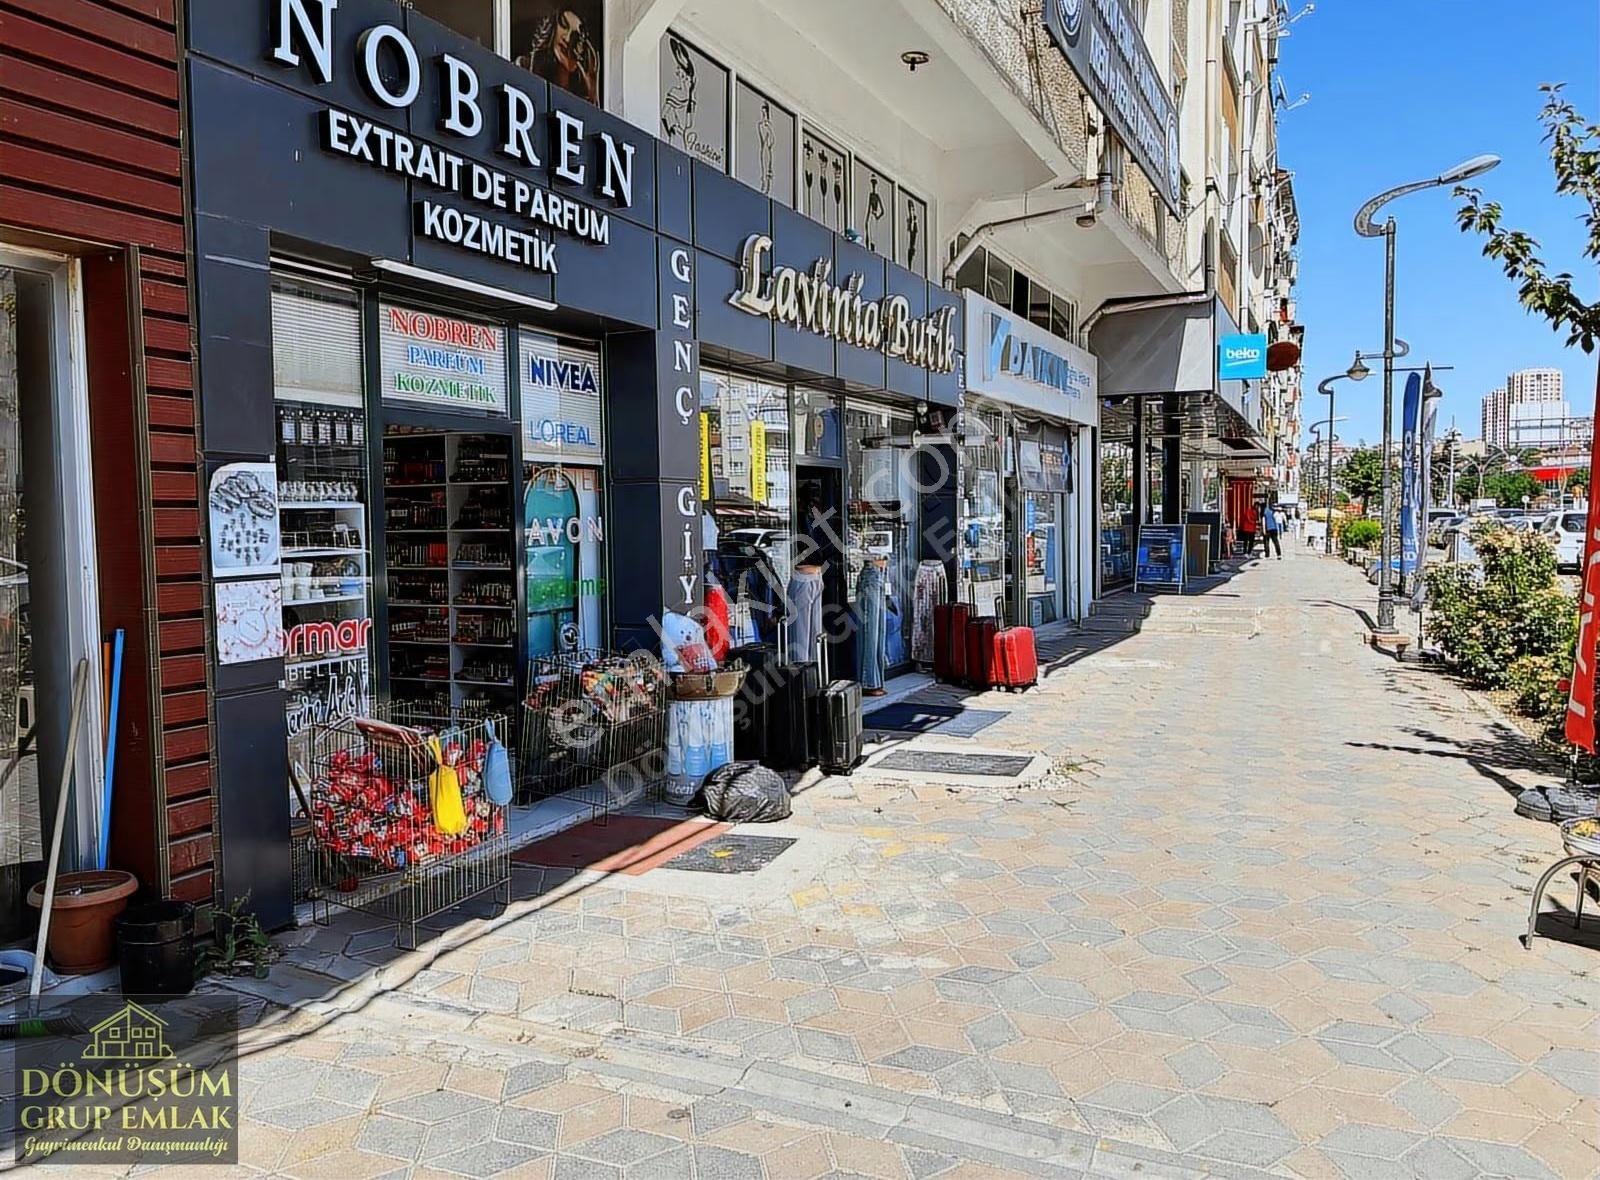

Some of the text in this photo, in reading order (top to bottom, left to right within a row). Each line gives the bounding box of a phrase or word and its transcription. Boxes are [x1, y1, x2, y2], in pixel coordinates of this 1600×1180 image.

[272, 0, 635, 208] NOBREN
[328, 107, 610, 246] EXTRAIT DE PARFUM
[423, 200, 559, 274] KOZMETİK
[730, 234, 957, 374] Lavinia Butik
[388, 308, 498, 351] NOBREN
[671, 250, 694, 425] GENÇ
[407, 345, 485, 375] PARFÜM
[528, 351, 599, 396] NIVEA
[1225, 346, 1261, 361] beko
[394, 372, 497, 403] KOZMETİK
[527, 516, 604, 547] AVON
